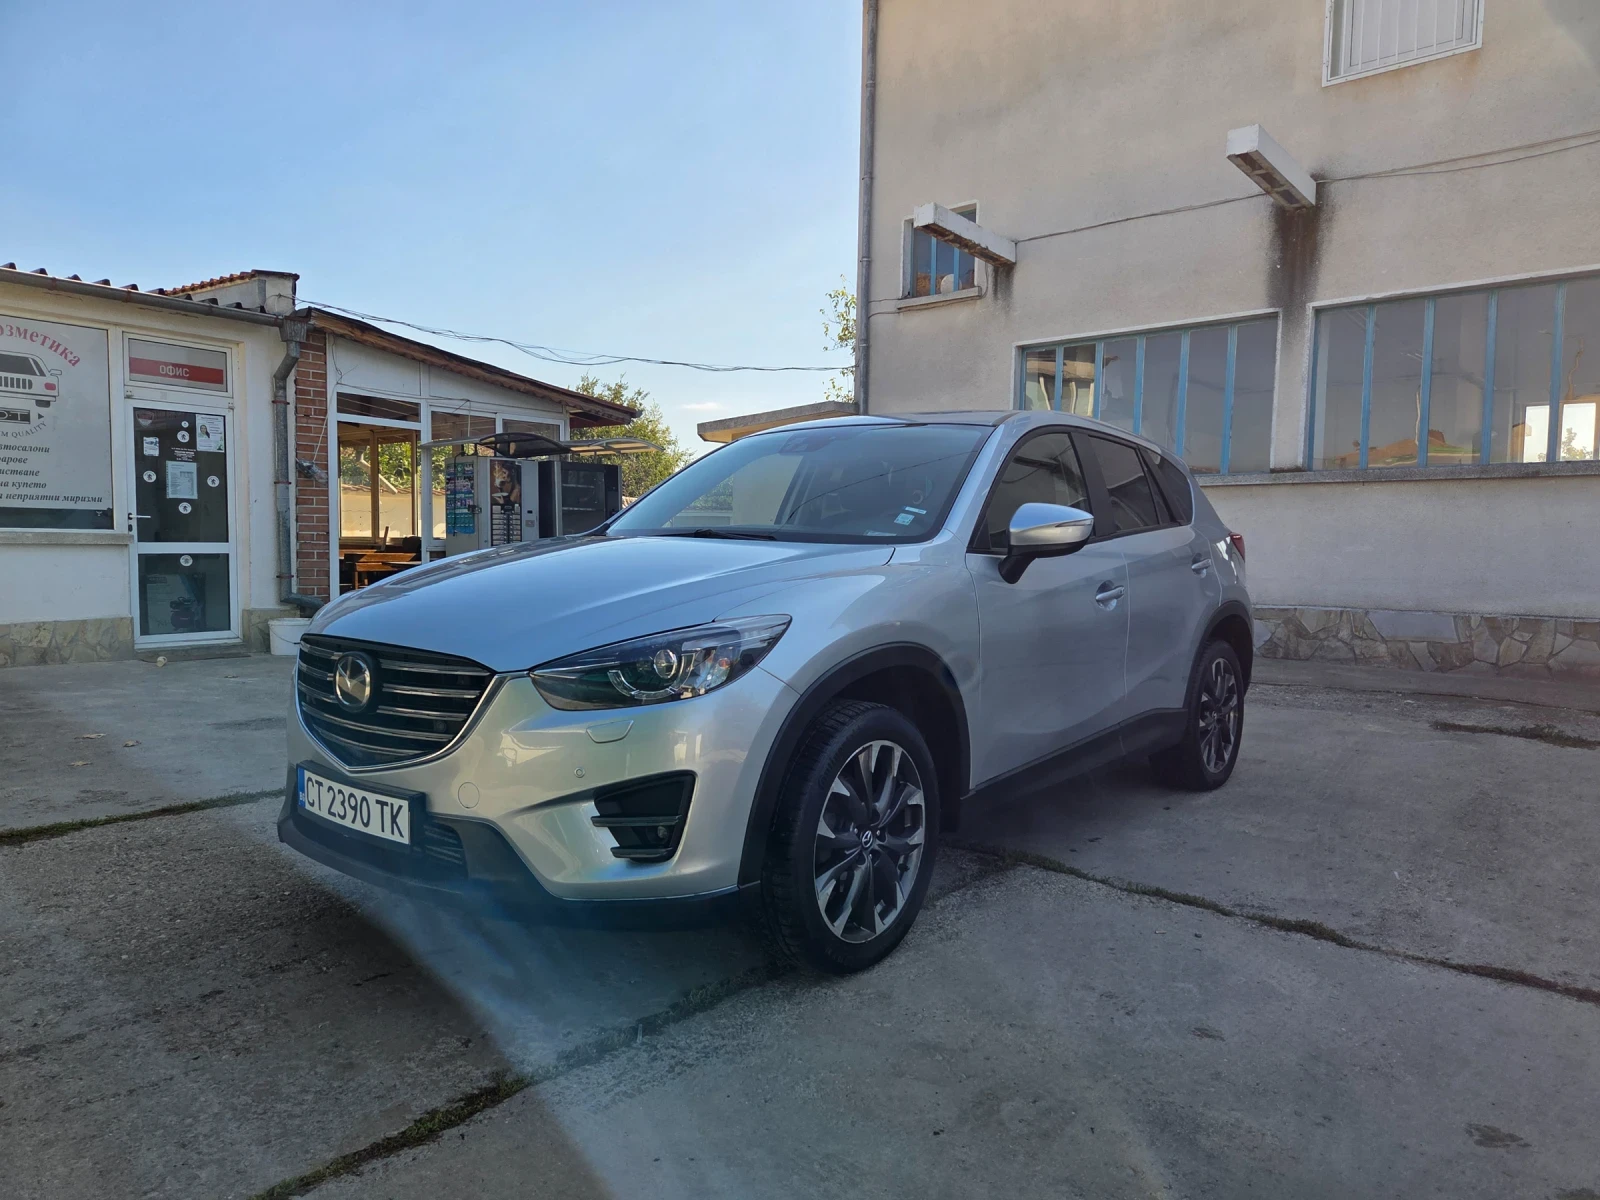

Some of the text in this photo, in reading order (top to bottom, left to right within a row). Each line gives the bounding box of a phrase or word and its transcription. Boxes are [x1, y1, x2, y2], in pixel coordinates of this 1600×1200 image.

[160, 365, 190, 377] ОФИС
[12, 421, 47, 439] QUALITY
[0, 456, 28, 465] арове
[12, 481, 47, 490] купето
[6, 492, 60, 503] неприятни
[62, 495, 103, 504] миризми
[306, 776, 404, 838] CT 2390 TK
